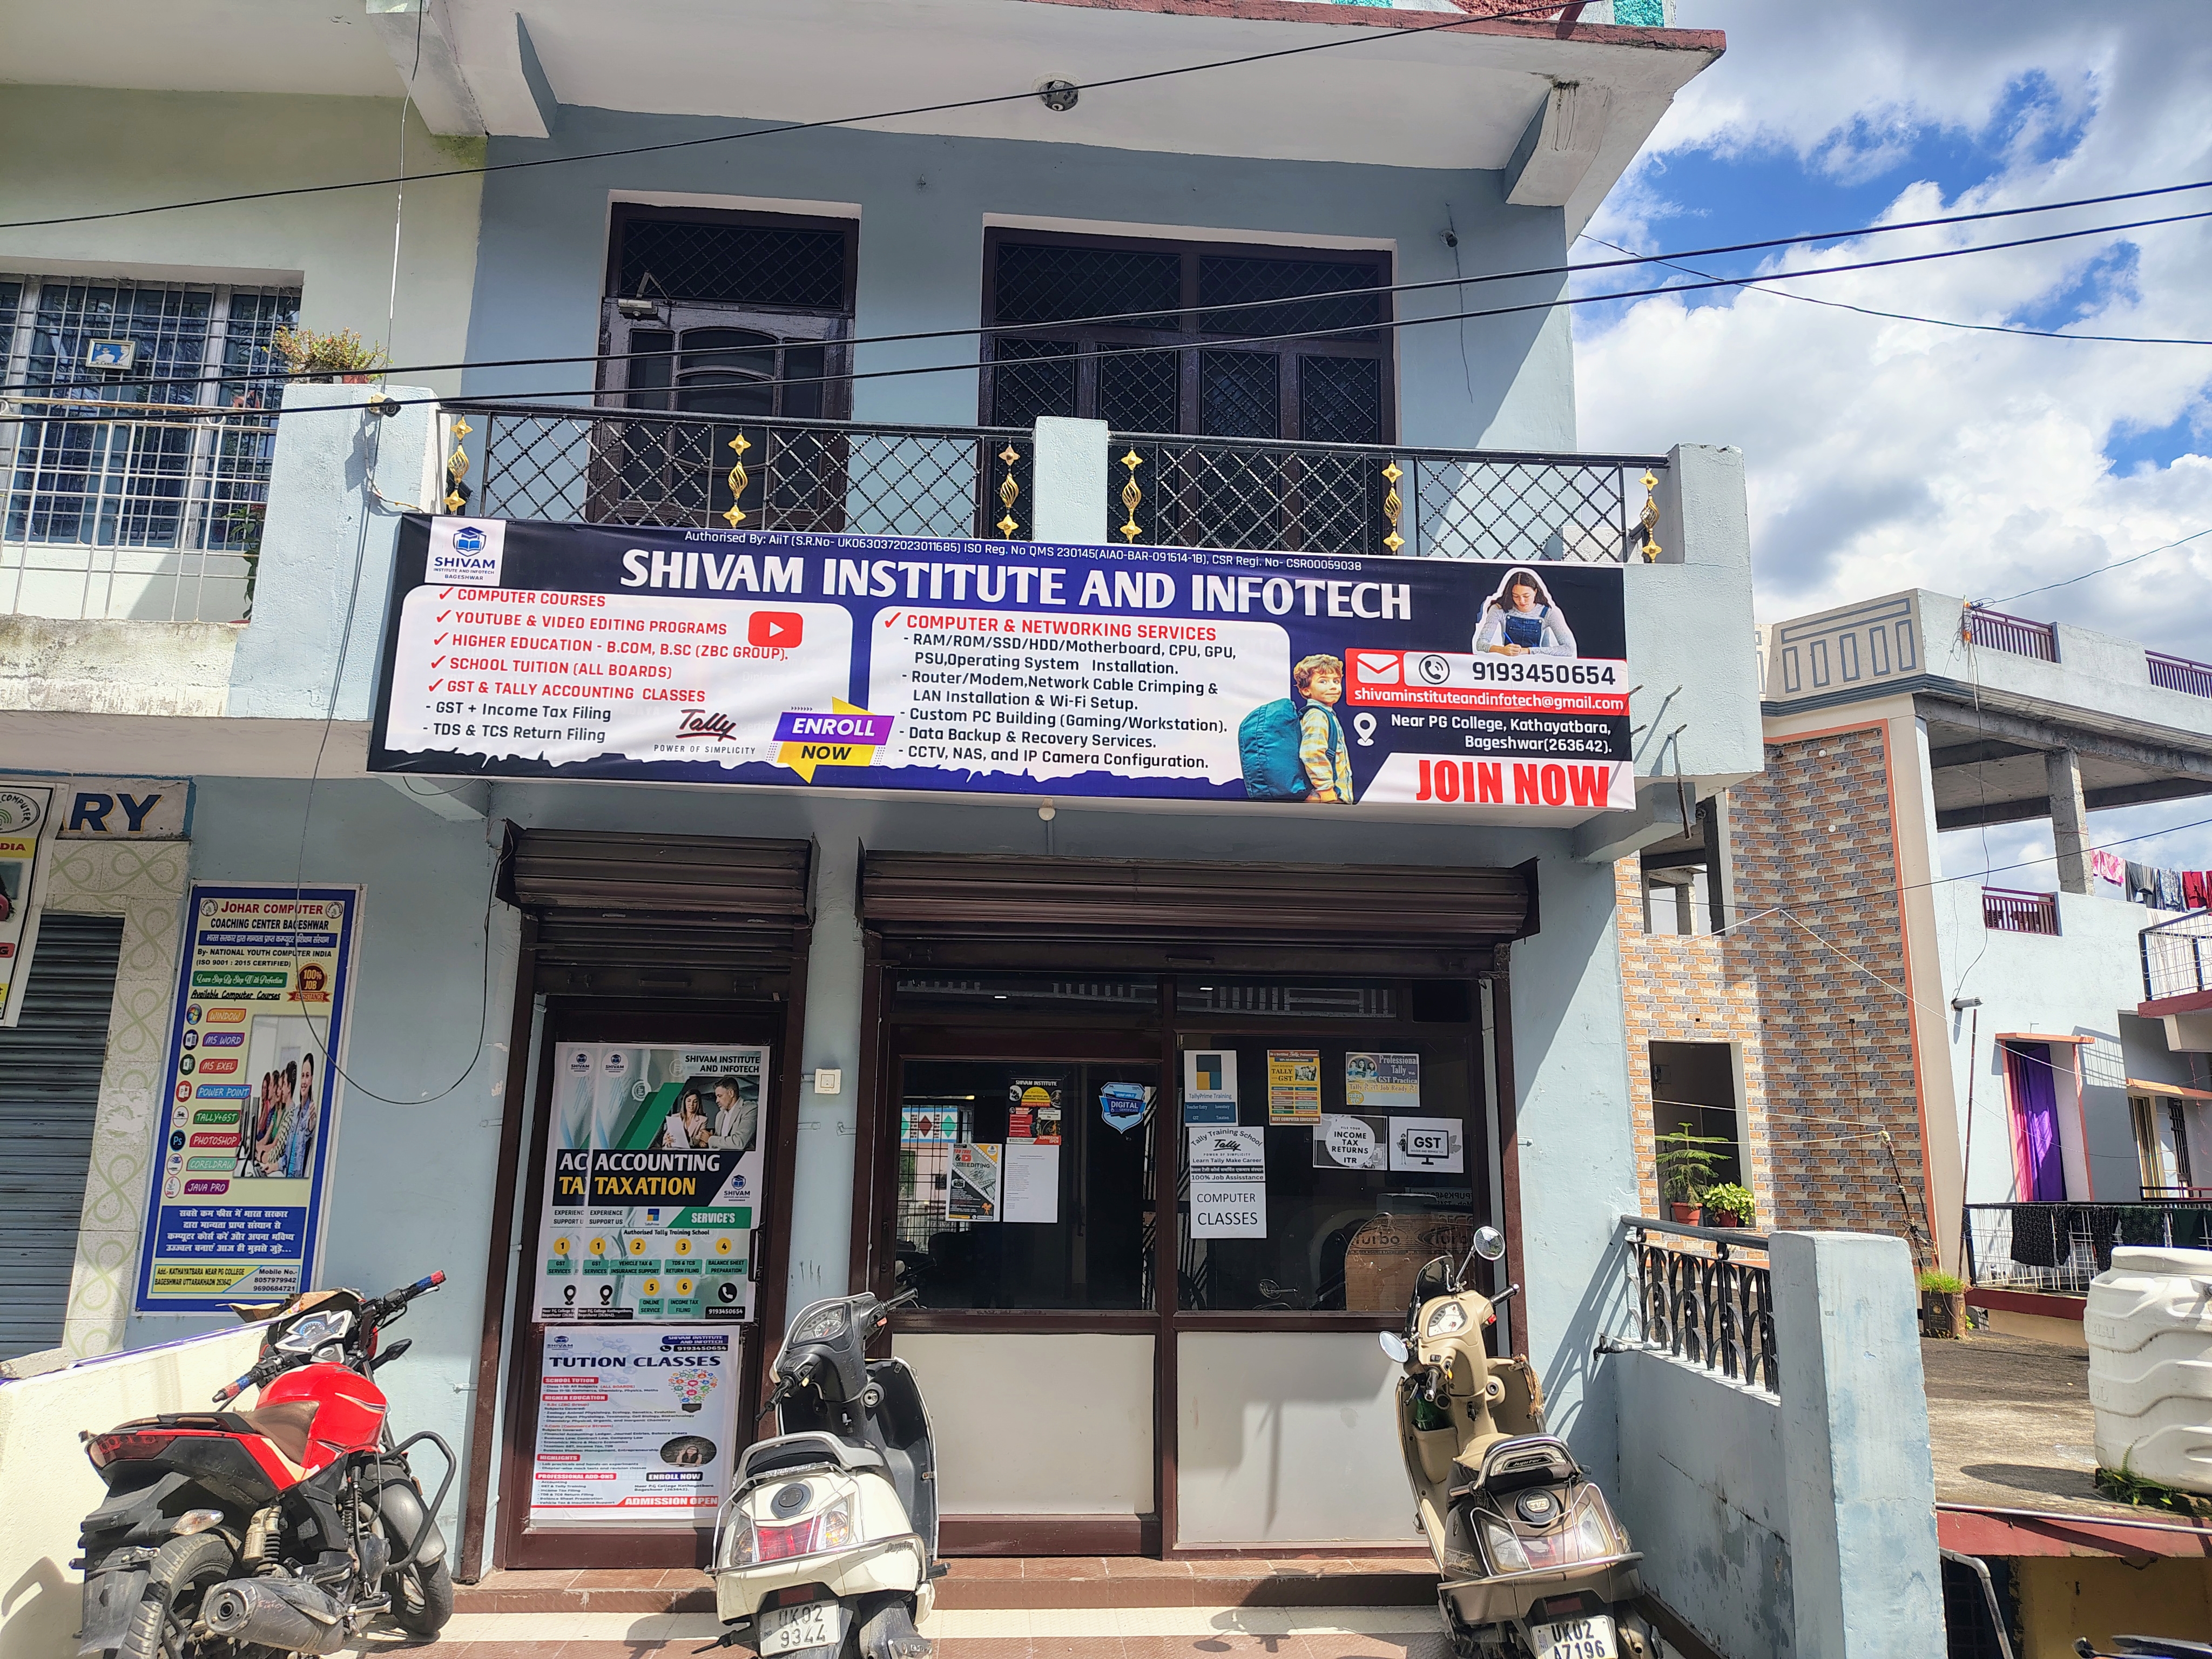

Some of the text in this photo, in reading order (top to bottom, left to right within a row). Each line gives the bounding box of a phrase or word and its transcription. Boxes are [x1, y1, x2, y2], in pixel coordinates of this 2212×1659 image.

[685, 531, 746, 543] Authorised
[750, 534, 766, 546] By:
[770, 535, 789, 545] AiiT
[792, 535, 834, 548] (S.R.No-
[838, 538, 961, 554] UK0630372023011685)
[965, 543, 981, 554] ISO
[985, 543, 1008, 556] Reg.
[1011, 545, 1026, 555] No
[1029, 545, 1054, 557] QMS
[1212, 554, 1233, 566] CSR
[1236, 555, 1263, 568] Regi.
[1265, 557, 1284, 567] No-
[1286, 557, 1361, 571] CSR00059038
[434, 557, 495, 569] SHIVAM
[621, 549, 1411, 621] SHIVAM INSTITUTE AND INFOTECH
[457, 589, 605, 608] COMPUTER COURSES
[456, 611, 727, 635] YOUTUBE VIDEO EDITING PROGRAMS
[907, 615, 1216, 642] COMPUTER NETWORKING SERVICES
[453, 634, 789, 662] HIGHER EDUCATION B.COM, B.SC (ZBC GROUP).
[914, 632, 1236, 660] RAM/ROM/SSD/HDD/Motherboard, CPU, GPU,
[450, 658, 672, 679] SCHOOL TUITION (ALL BOARDS)
[915, 651, 1178, 675] PSU,Operating System Installation.
[1472, 661, 1615, 685] 9193450654
[448, 680, 705, 702] GST TALLY ACCOUNTING CLASSES
[912, 670, 1204, 696] Router/Modem,Network Cable Crimping
[913, 689, 1138, 712] LAN Installation Wi-Fi Setup.
[1354, 689, 1623, 711] shivaminstituteandinfotech@gmail.com
[436, 702, 611, 721] GST Income Tax Filing
[910, 707, 1227, 733] Custom PC Building (Gaming/Workstation).
[434, 723, 605, 743] TDS TCS Return Filing
[676, 708, 739, 742] Tally
[793, 718, 875, 736] ENROLL
[1391, 713, 1611, 737] Near PG College, Kathayatbara,
[909, 726, 1156, 748] Data Backup Recovery Services.
[1465, 736, 1612, 754] Bageshwar(263642).
[654, 745, 756, 754] POWER OF SIMPLICITY
[801, 746, 852, 760] NOW
[908, 745, 1209, 769] CCTV, NAS, and IP Camera Configuration.
[1416, 759, 1609, 807] JOIN NOW
[60, 793, 162, 831] RY
[221, 901, 259, 913] JOHAR
[211, 919, 249, 928] COACHING
[252, 919, 280, 929] CENTER
[206, 1036, 241, 1045] MS WORD
[202, 1062, 234, 1070] MS EXEL
[199, 1087, 249, 1097] POWER POINT
[196, 1113, 237, 1122] TALLY+GST
[193, 1136, 237, 1145] PHOTOSHOP
[1414, 1137, 1441, 1148] GST
[595, 1154, 720, 1171] ACCOUNTING
[188, 1183, 226, 1192] JAVA PRO
[595, 1177, 696, 1195] TAXATION
[1197, 1193, 1256, 1202] COMPUTER
[691, 1213, 736, 1223] SERVICE'S
[1198, 1212, 1258, 1225] CLASSES
[550, 1356, 721, 1367] TUTION CLASSES
[779, 1604, 823, 1627] UK02
[781, 1624, 825, 1648] 9344
[1551, 1620, 1594, 1642] UK02
